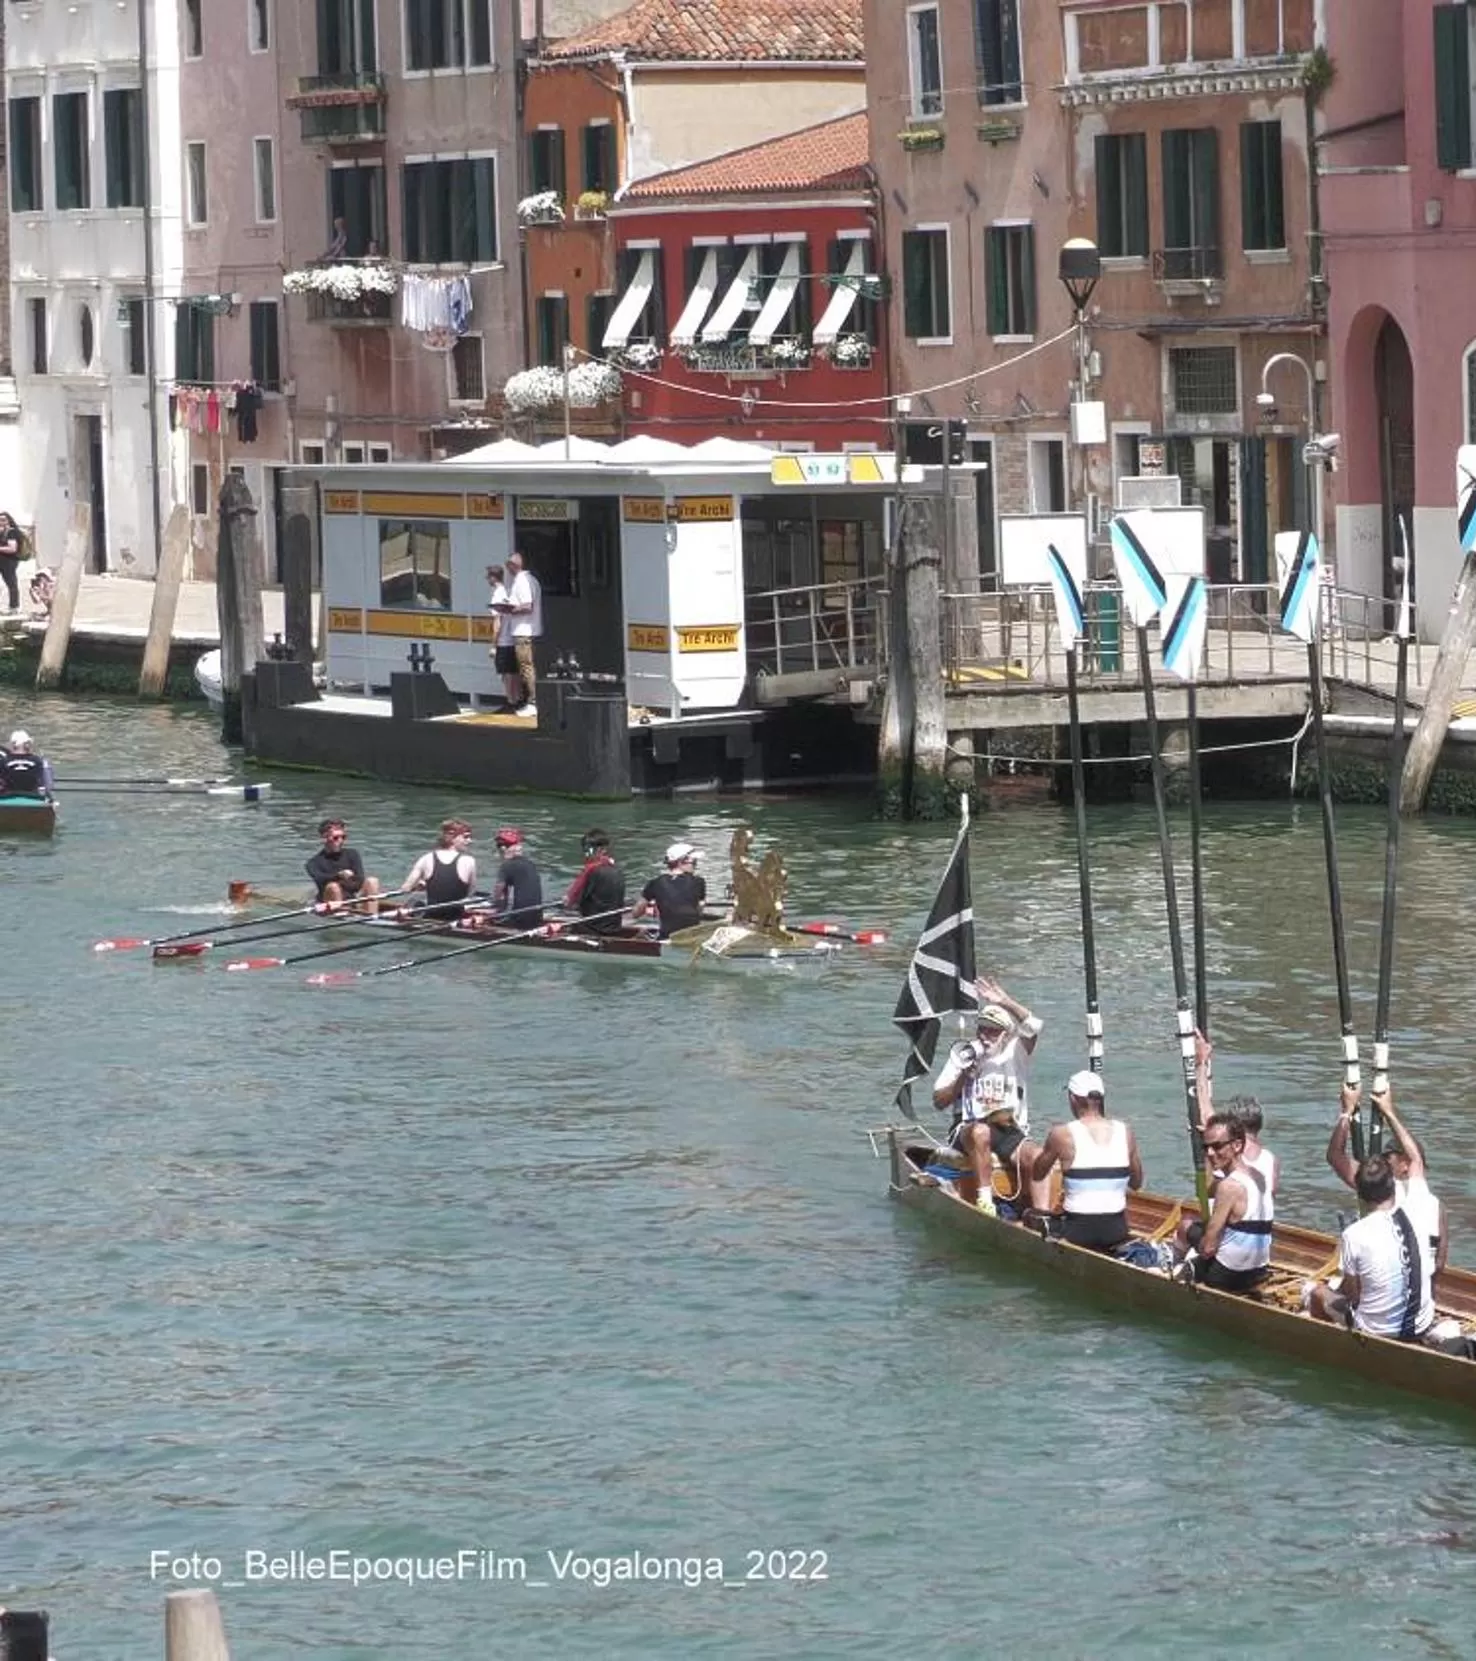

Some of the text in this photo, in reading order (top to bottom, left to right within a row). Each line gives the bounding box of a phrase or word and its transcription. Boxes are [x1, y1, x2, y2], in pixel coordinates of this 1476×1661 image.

[700, 503, 729, 516] Archi
[682, 631, 734, 645] Tre Archi
